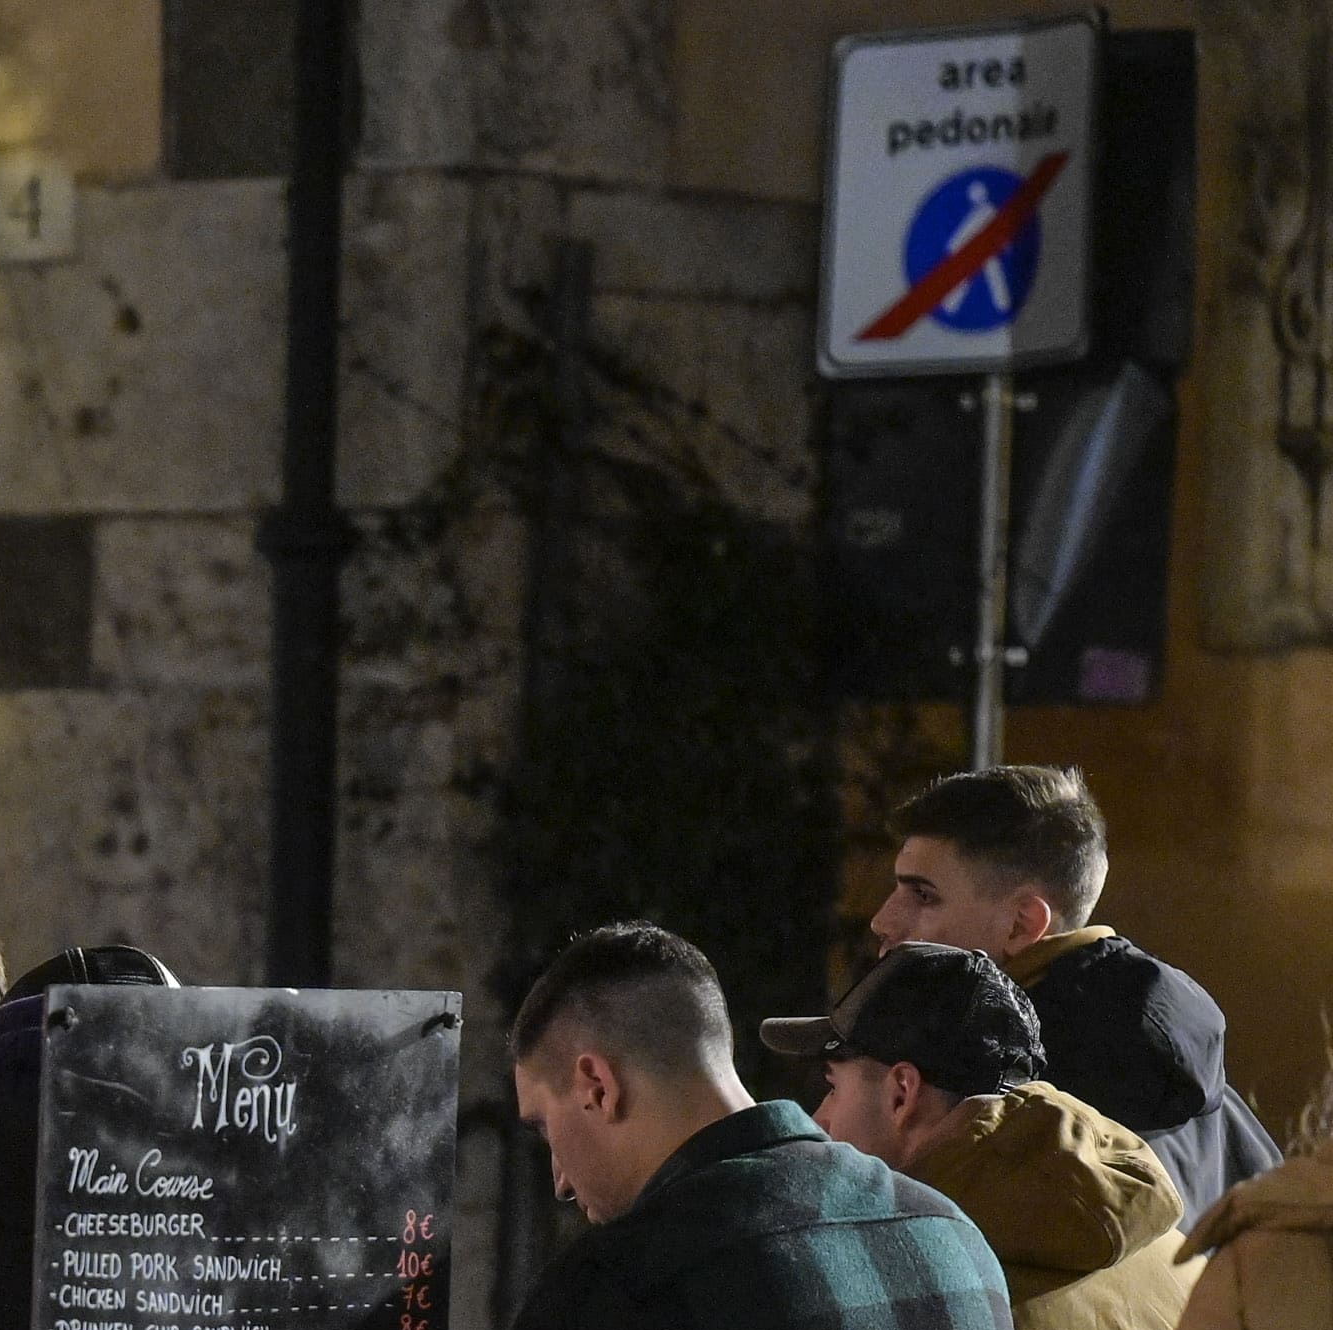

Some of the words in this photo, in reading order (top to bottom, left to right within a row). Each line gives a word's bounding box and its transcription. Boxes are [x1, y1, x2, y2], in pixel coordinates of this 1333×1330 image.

[939, 57, 1026, 90] area
[181, 1035, 297, 1143] Menu
[68, 1147, 129, 1194] Main
[135, 1148, 214, 1200] Course
[64, 1212, 205, 1239] CHEESEBURGER
[63, 1250, 122, 1279] PULLED
[131, 1252, 179, 1281] PORK
